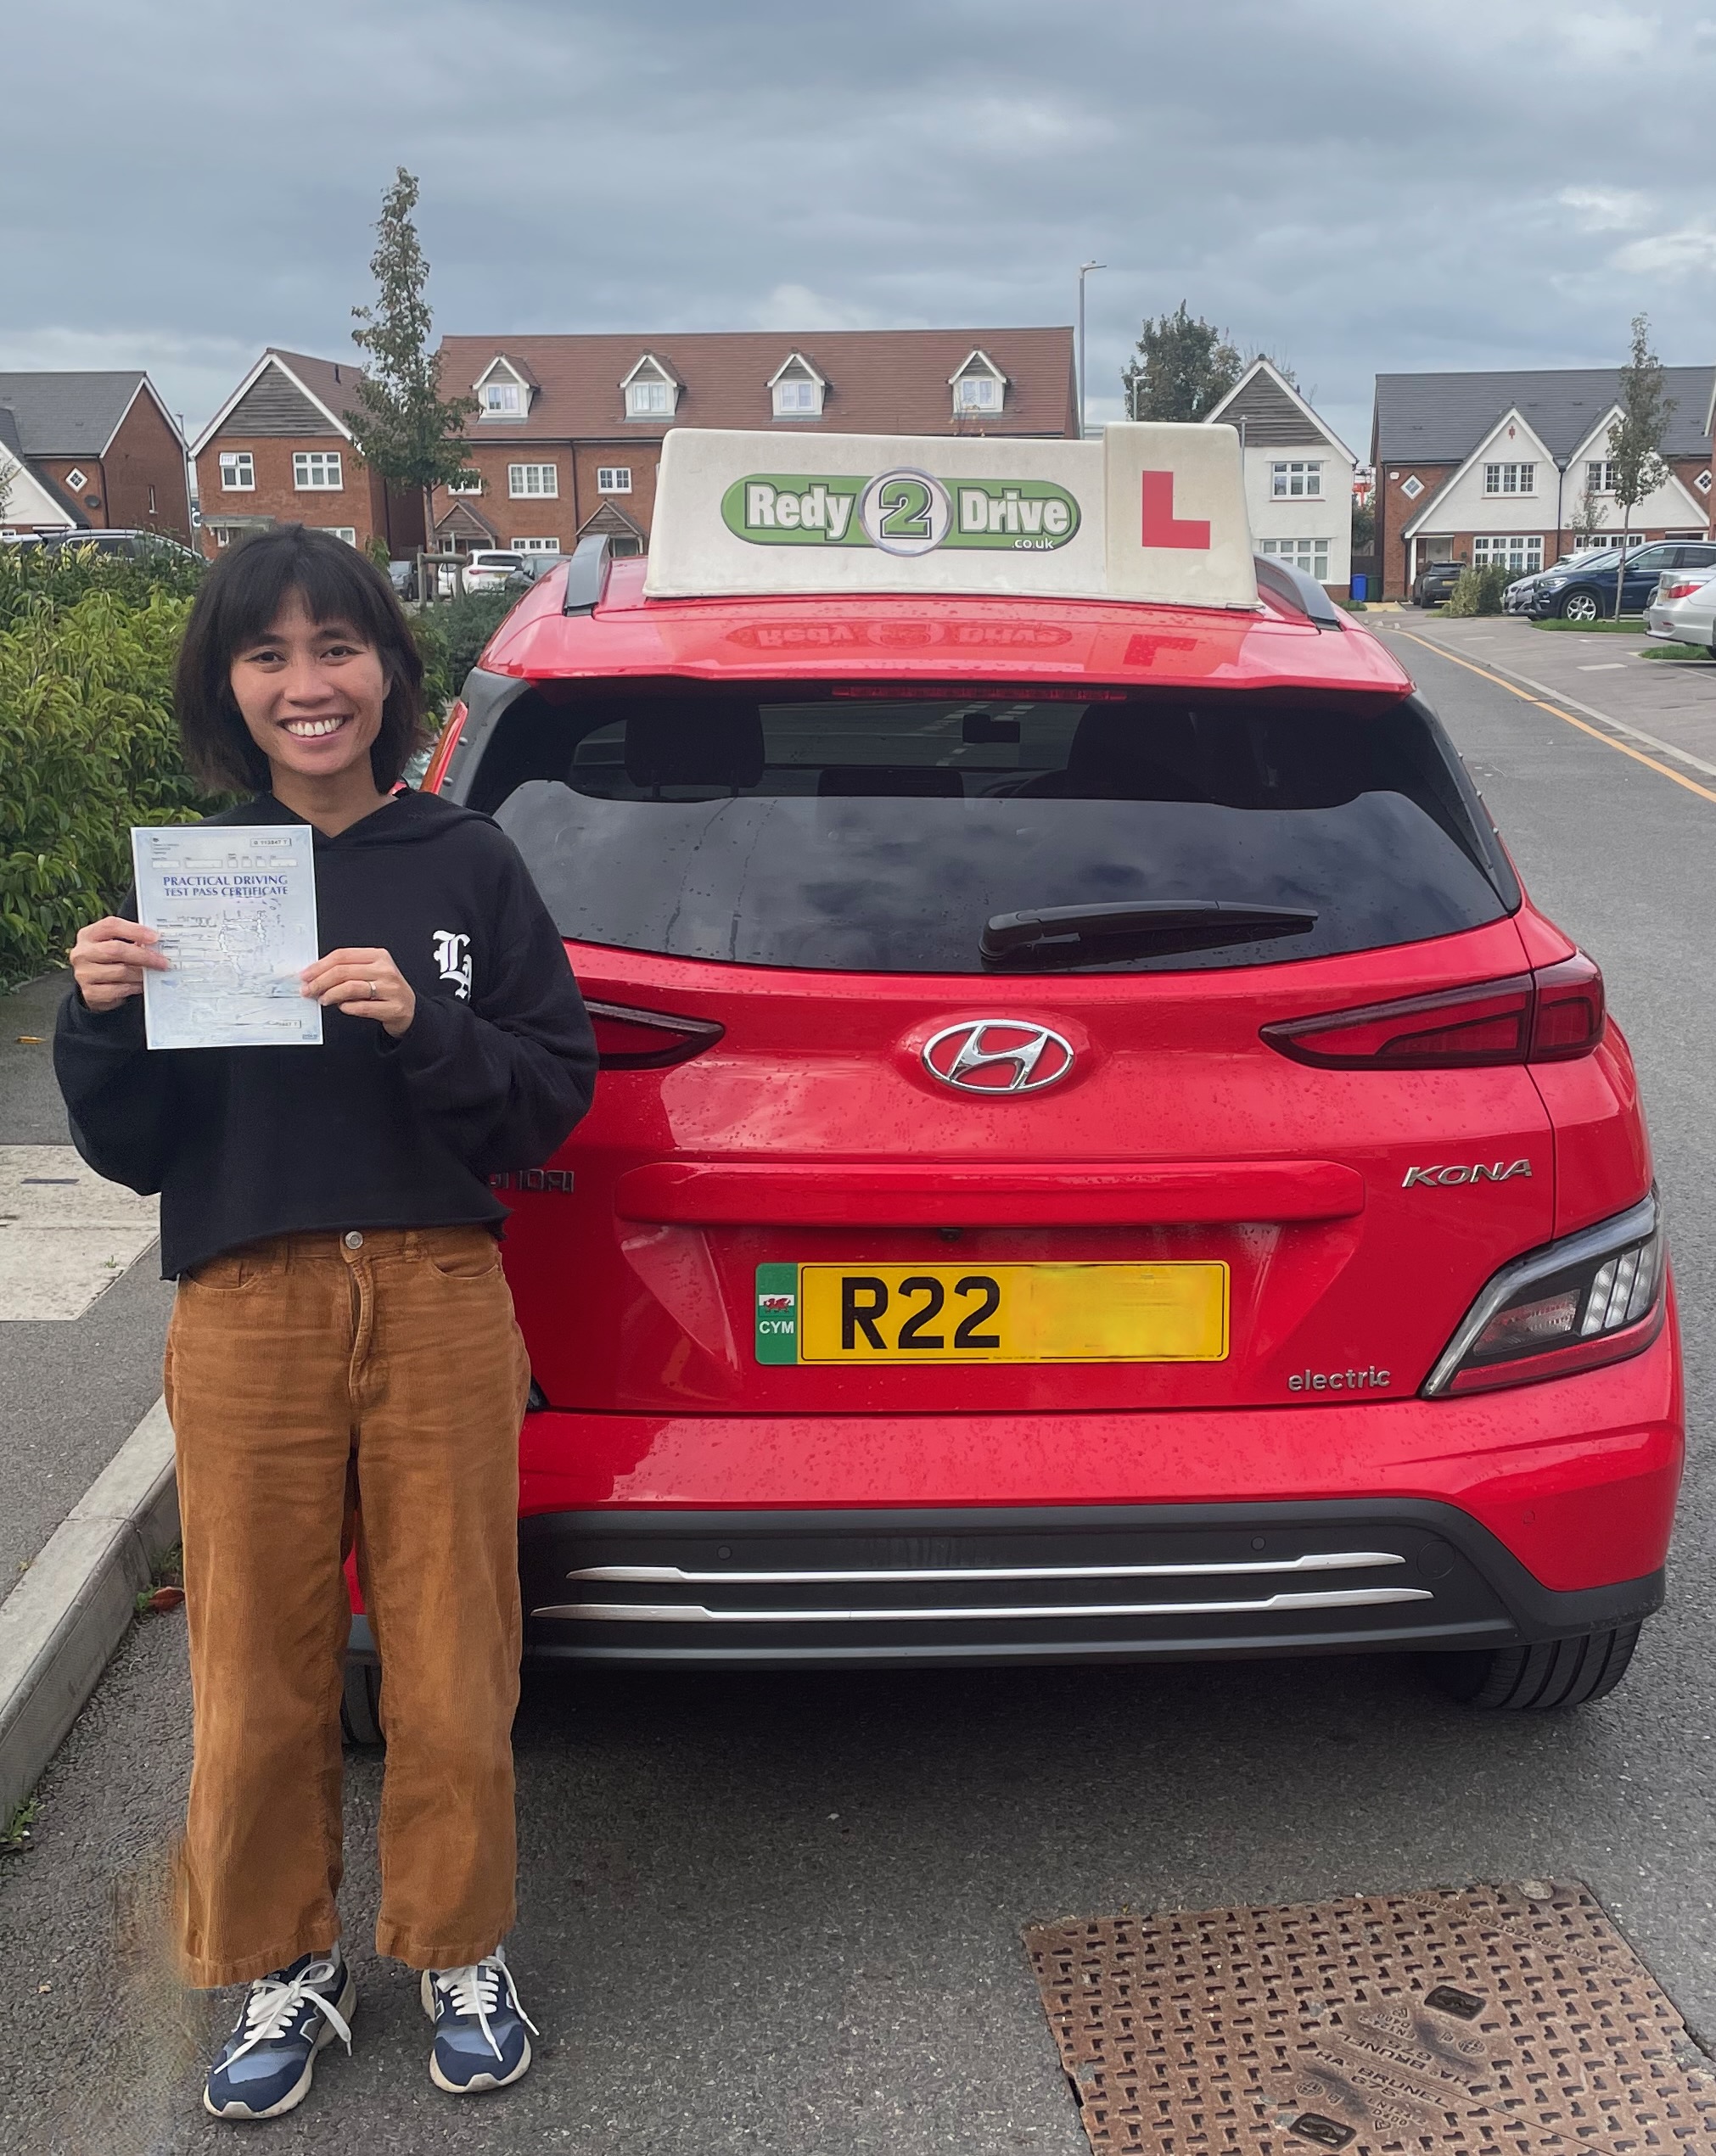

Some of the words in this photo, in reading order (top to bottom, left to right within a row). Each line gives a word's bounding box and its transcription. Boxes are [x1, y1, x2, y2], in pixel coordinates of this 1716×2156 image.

[748, 484, 854, 540] Redy
[880, 479, 932, 538] 2
[960, 489, 1069, 535] Drive
[1142, 470, 1210, 550] L
[163, 876, 230, 886] PRACTICAL
[233, 875, 288, 885] DRIVING
[165, 888, 188, 896] TEST
[193, 887, 218, 896] PASS
[222, 886, 288, 897] CERTIFICATE
[1401, 1159, 1533, 1188] KONA
[759, 1320, 794, 1334] CYM
[841, 1276, 1000, 1350] R22
[1288, 1365, 1391, 1392] electric
[1338, 2030, 1427, 2071] BRUNEL
[1358, 2067, 1449, 2109] BRUNEL
